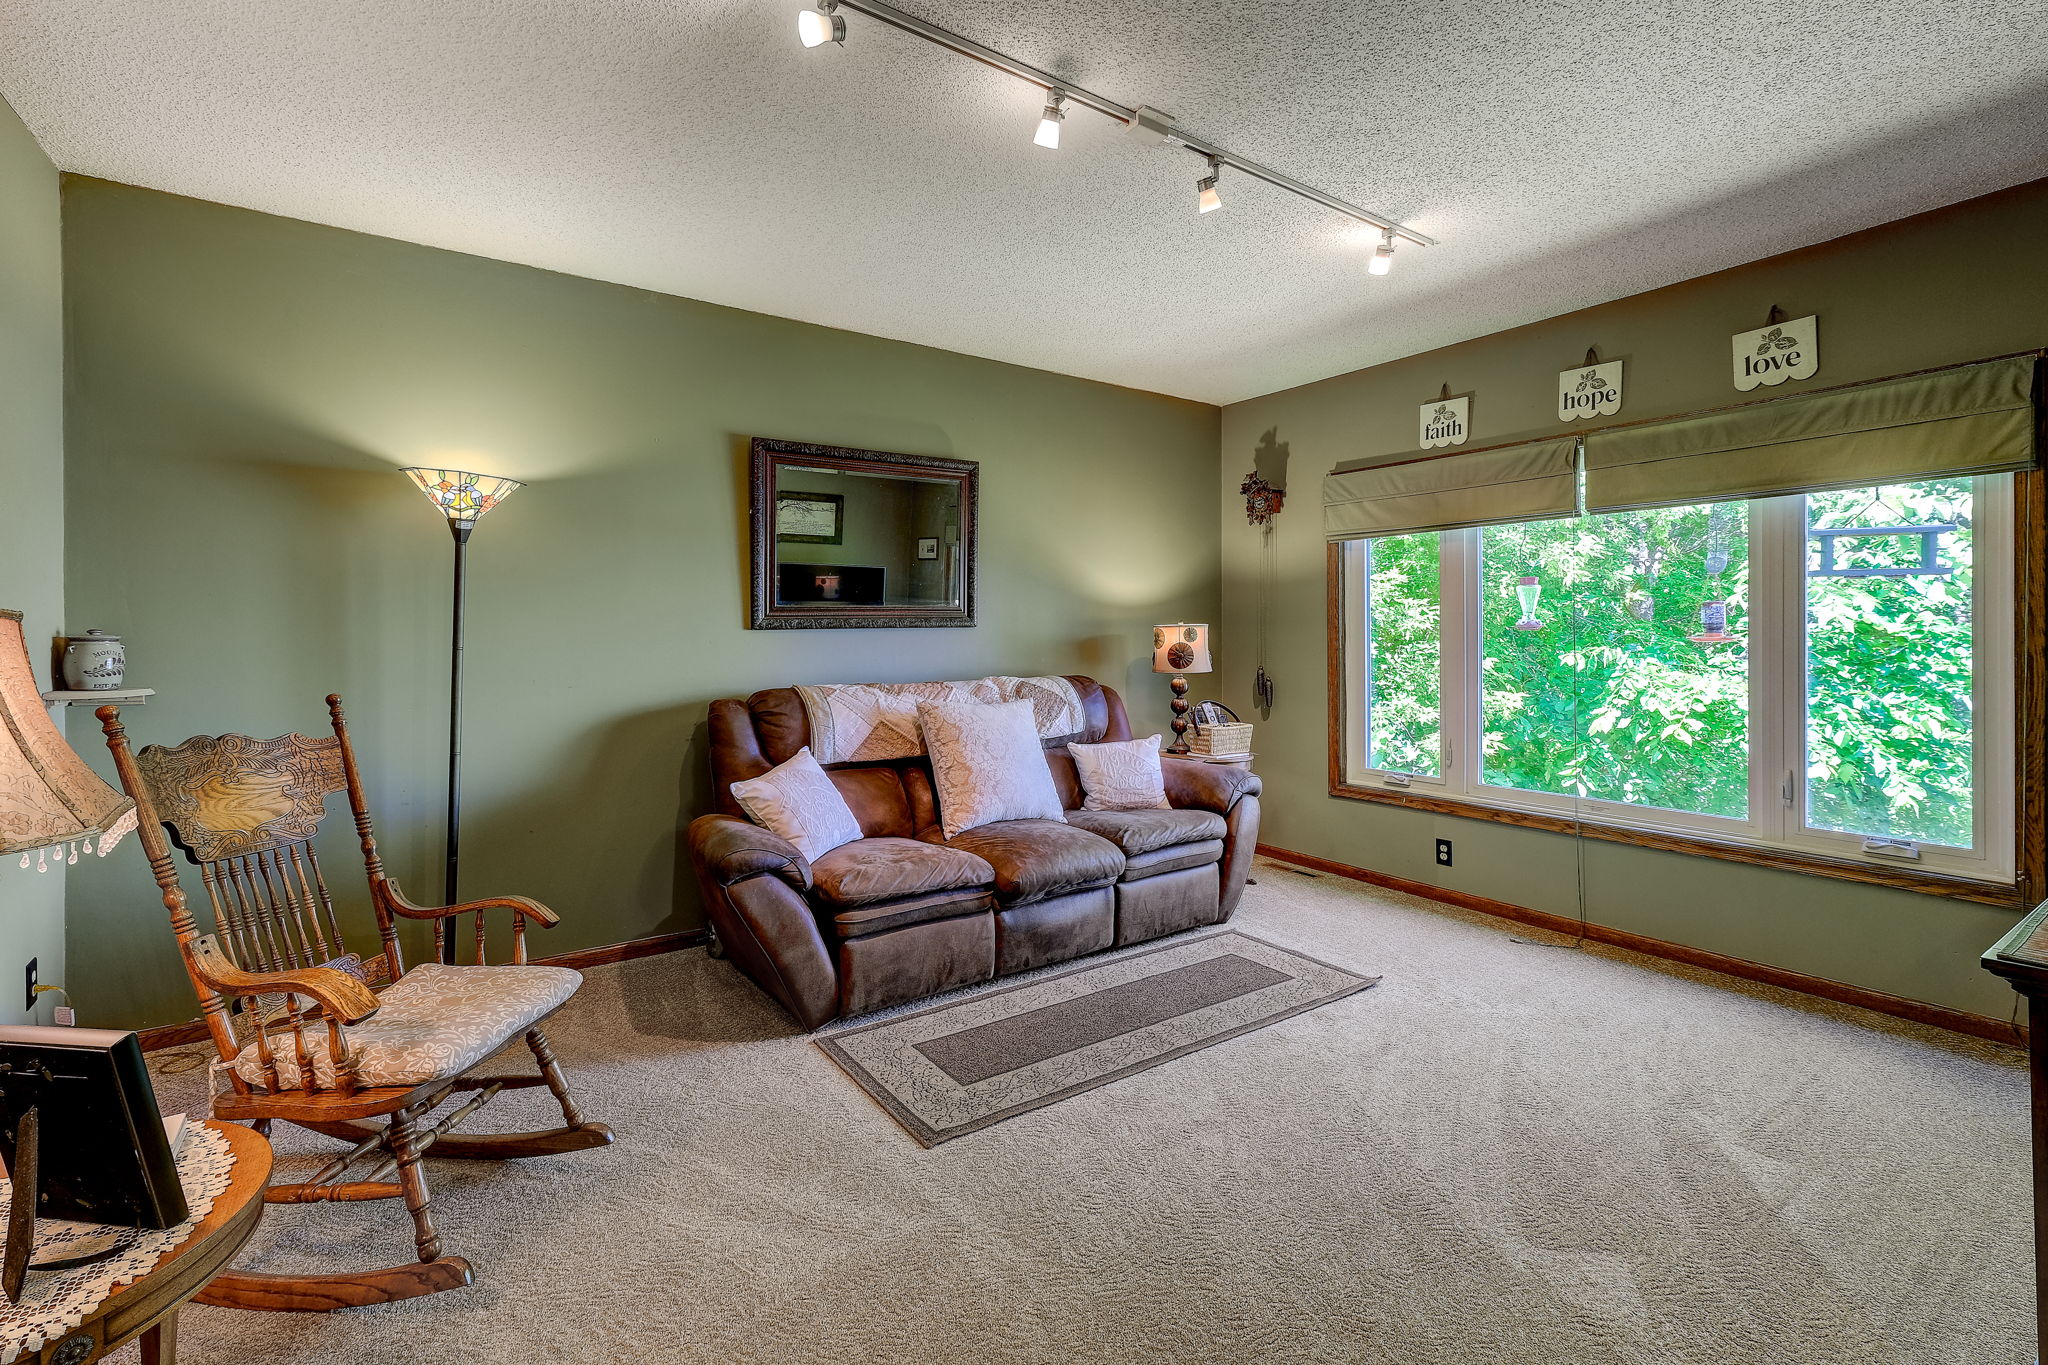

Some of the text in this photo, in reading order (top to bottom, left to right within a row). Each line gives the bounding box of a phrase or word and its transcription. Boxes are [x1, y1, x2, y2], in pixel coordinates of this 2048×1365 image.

[1744, 351, 1802, 376] love
[1563, 388, 1617, 410] hope
[1425, 420, 1462, 440] faith
